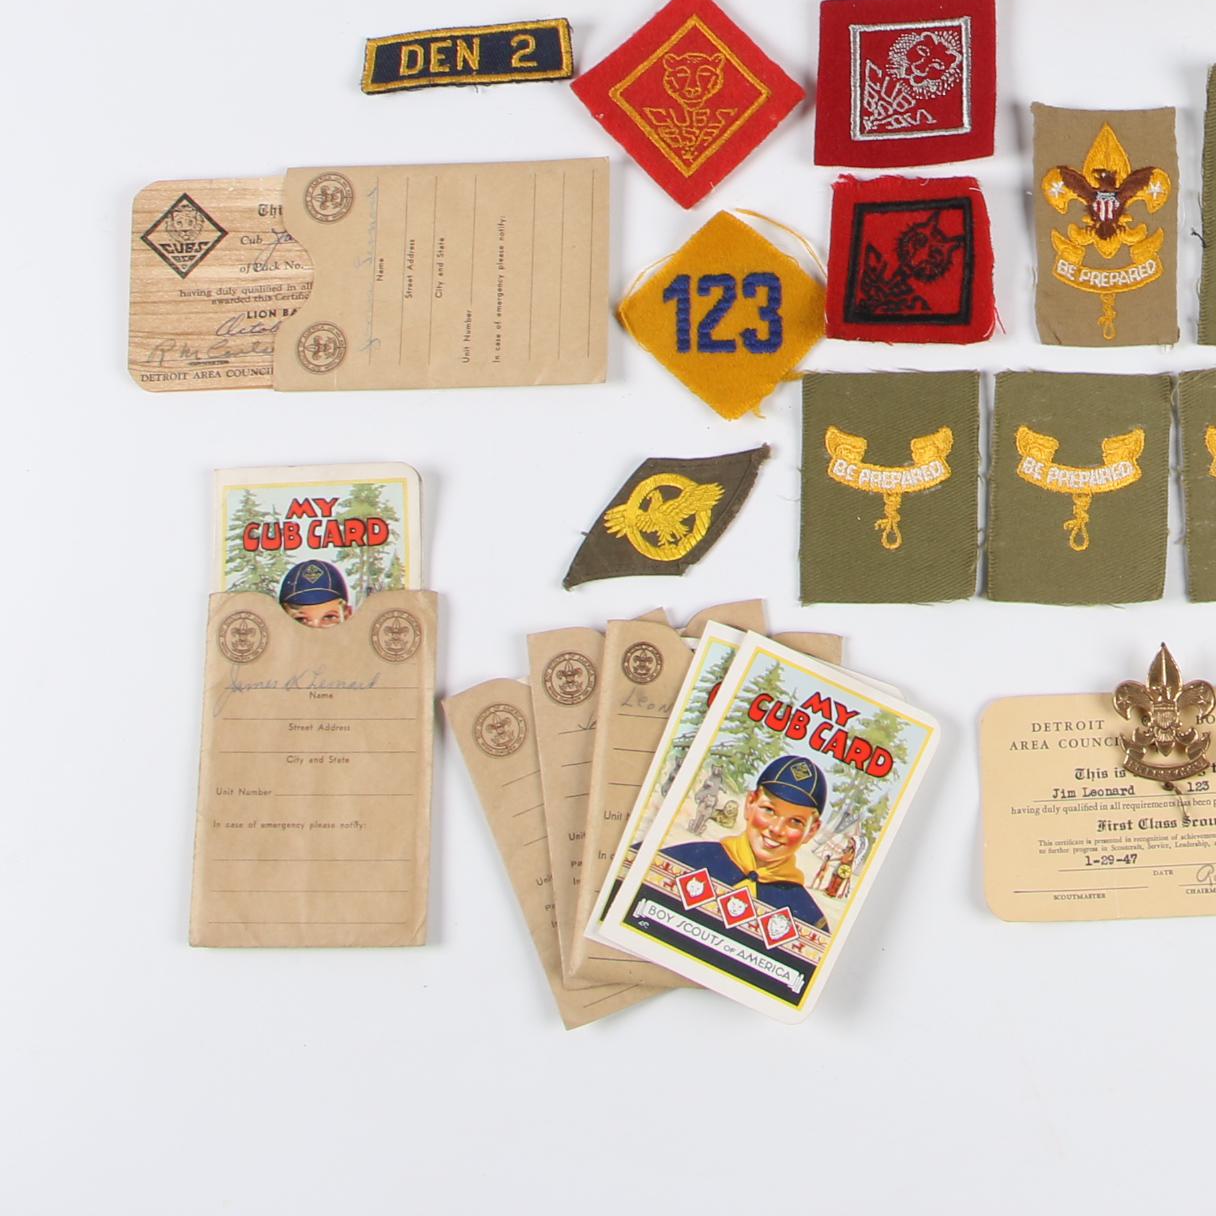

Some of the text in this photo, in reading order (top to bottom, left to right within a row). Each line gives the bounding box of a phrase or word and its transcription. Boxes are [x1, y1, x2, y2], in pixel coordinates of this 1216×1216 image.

[399, 34, 537, 77] DEN 2
[644, 107, 738, 129] CUBS
[1057, 260, 1157, 288] BE PREPARED
[247, 309, 277, 319] LION
[662, 272, 783, 355] 123
[141, 372, 187, 382] DETROIT
[193, 370, 221, 380] AREA
[833, 458, 943, 487] BE PREPARED
[1024, 457, 1133, 486] BE PREPARED
[286, 496, 339, 519] MY
[242, 518, 390, 552] CUB CARD
[309, 691, 333, 699] Name
[801, 689, 862, 726] MY
[288, 723, 350, 731] Street Address
[748, 692, 893, 779] CUB CARD
[1031, 719, 1104, 733] DETROIT
[1009, 738, 1049, 751] AREA
[1074, 767, 1108, 782] This
[1114, 767, 1126, 779] is
[1052, 785, 1135, 799] Jim Leonard
[1187, 781, 1210, 792] 123
[1096, 819, 1134, 833] First
[1138, 817, 1178, 830] Class
[1085, 853, 1138, 866] 1-29-47
[648, 905, 674, 923] BOY
[676, 920, 724, 946] SCOUTS
[737, 950, 791, 980] AMERICA
